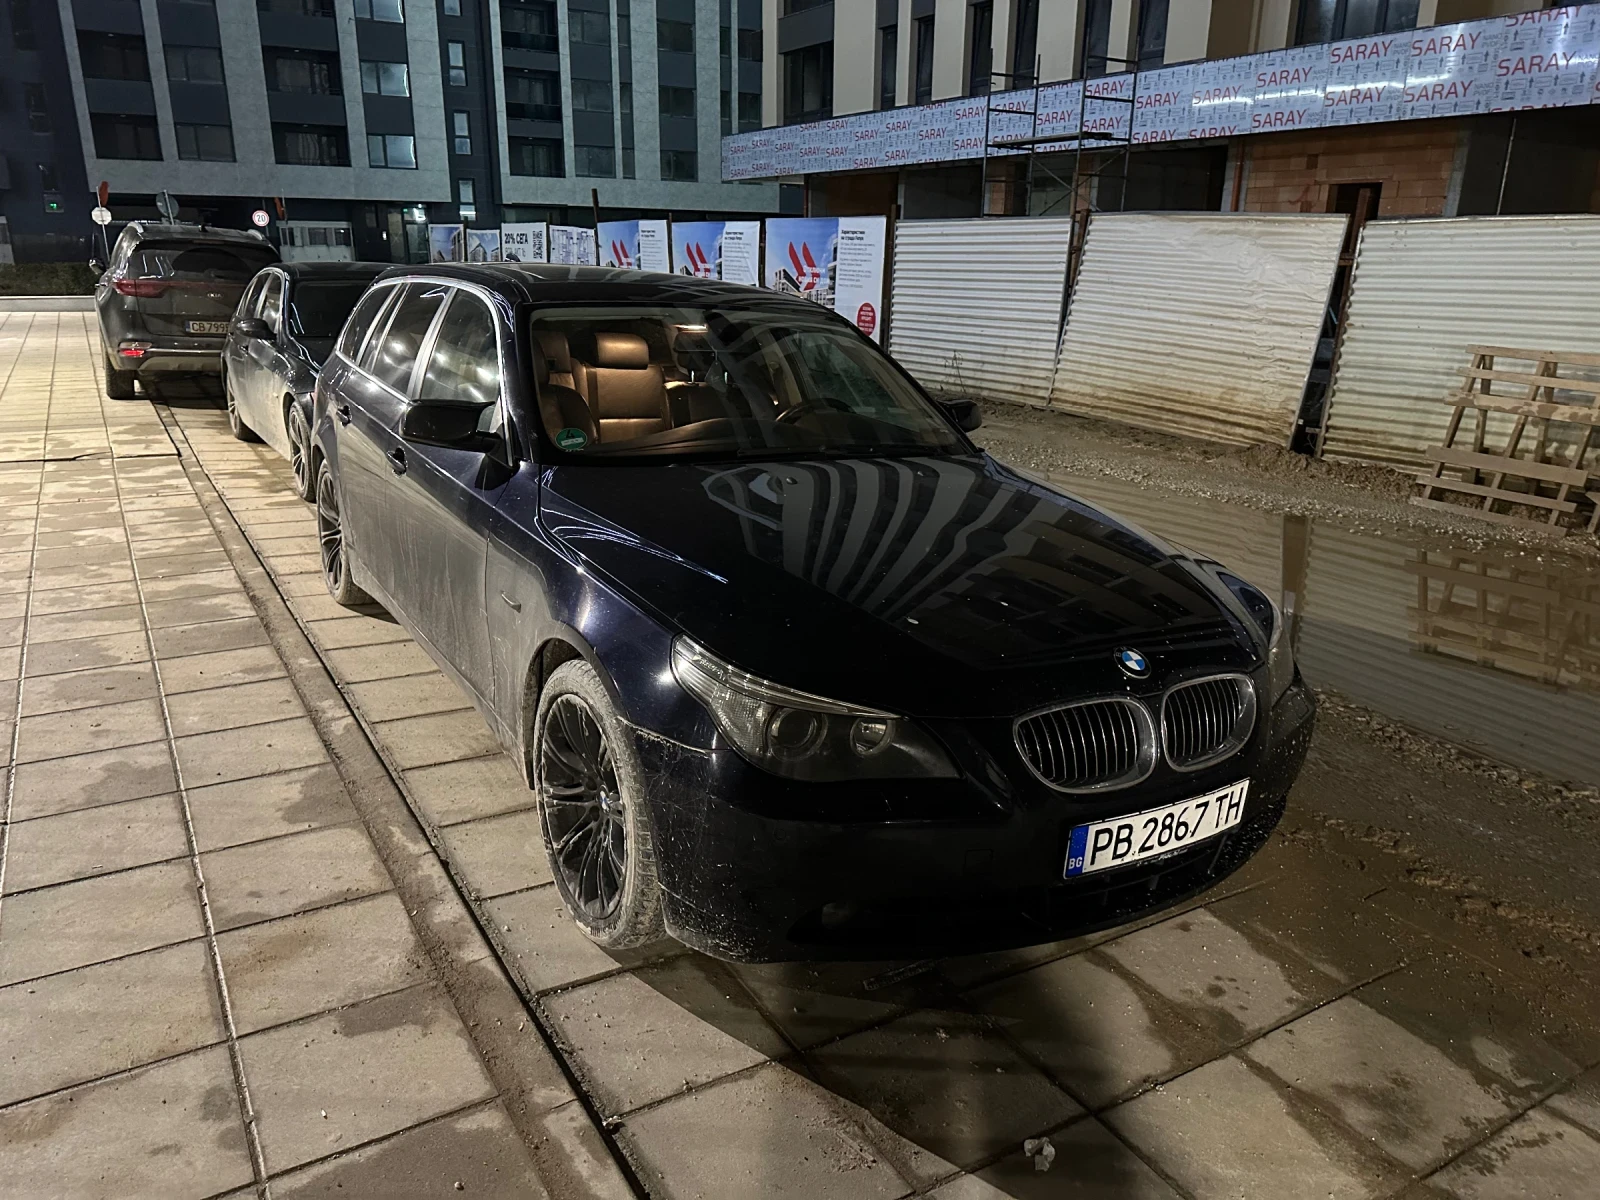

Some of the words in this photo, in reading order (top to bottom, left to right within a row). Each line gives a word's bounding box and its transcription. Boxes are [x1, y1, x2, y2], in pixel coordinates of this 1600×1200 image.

[1411, 31, 1482, 57] SARAY
[1330, 39, 1393, 64] SARAY
[1496, 51, 1577, 77] SARAY
[1256, 66, 1313, 88] SARAY
[1086, 80, 1126, 96] SARAY
[1193, 85, 1242, 105] SARAY
[1404, 80, 1474, 103] SARAY
[1135, 91, 1181, 109] SARAY
[1324, 85, 1386, 107] SARAY
[955, 105, 987, 120] SARAY
[1036, 109, 1074, 125] SARAY
[1251, 109, 1307, 129] SARAY
[826, 120, 849, 131] SARAY
[885, 120, 913, 133] SARAY
[1083, 116, 1123, 132] SARAY
[855, 129, 880, 141] SARAY
[919, 127, 948, 140] SARAY
[730, 144, 748, 155] SARAY
[751, 138, 771, 149] SARAY
[775, 142, 795, 153] SARAY
[954, 137, 985, 151] SARAY
[800, 146, 820, 158] SARAY
[825, 146, 849, 158] SARAY
[884, 149, 911, 161] SARAY
[751, 162, 771, 173] SARAY
[854, 157, 879, 168] SARAY
[256, 214, 266, 223] 20
[504, 232, 516, 245] 20%
[191, 322, 206, 332] CB
[1089, 823, 1133, 866] PB
[1137, 800, 1210, 854] 2867
[1215, 786, 1244, 829] TH
[1068, 856, 1083, 870] BG
